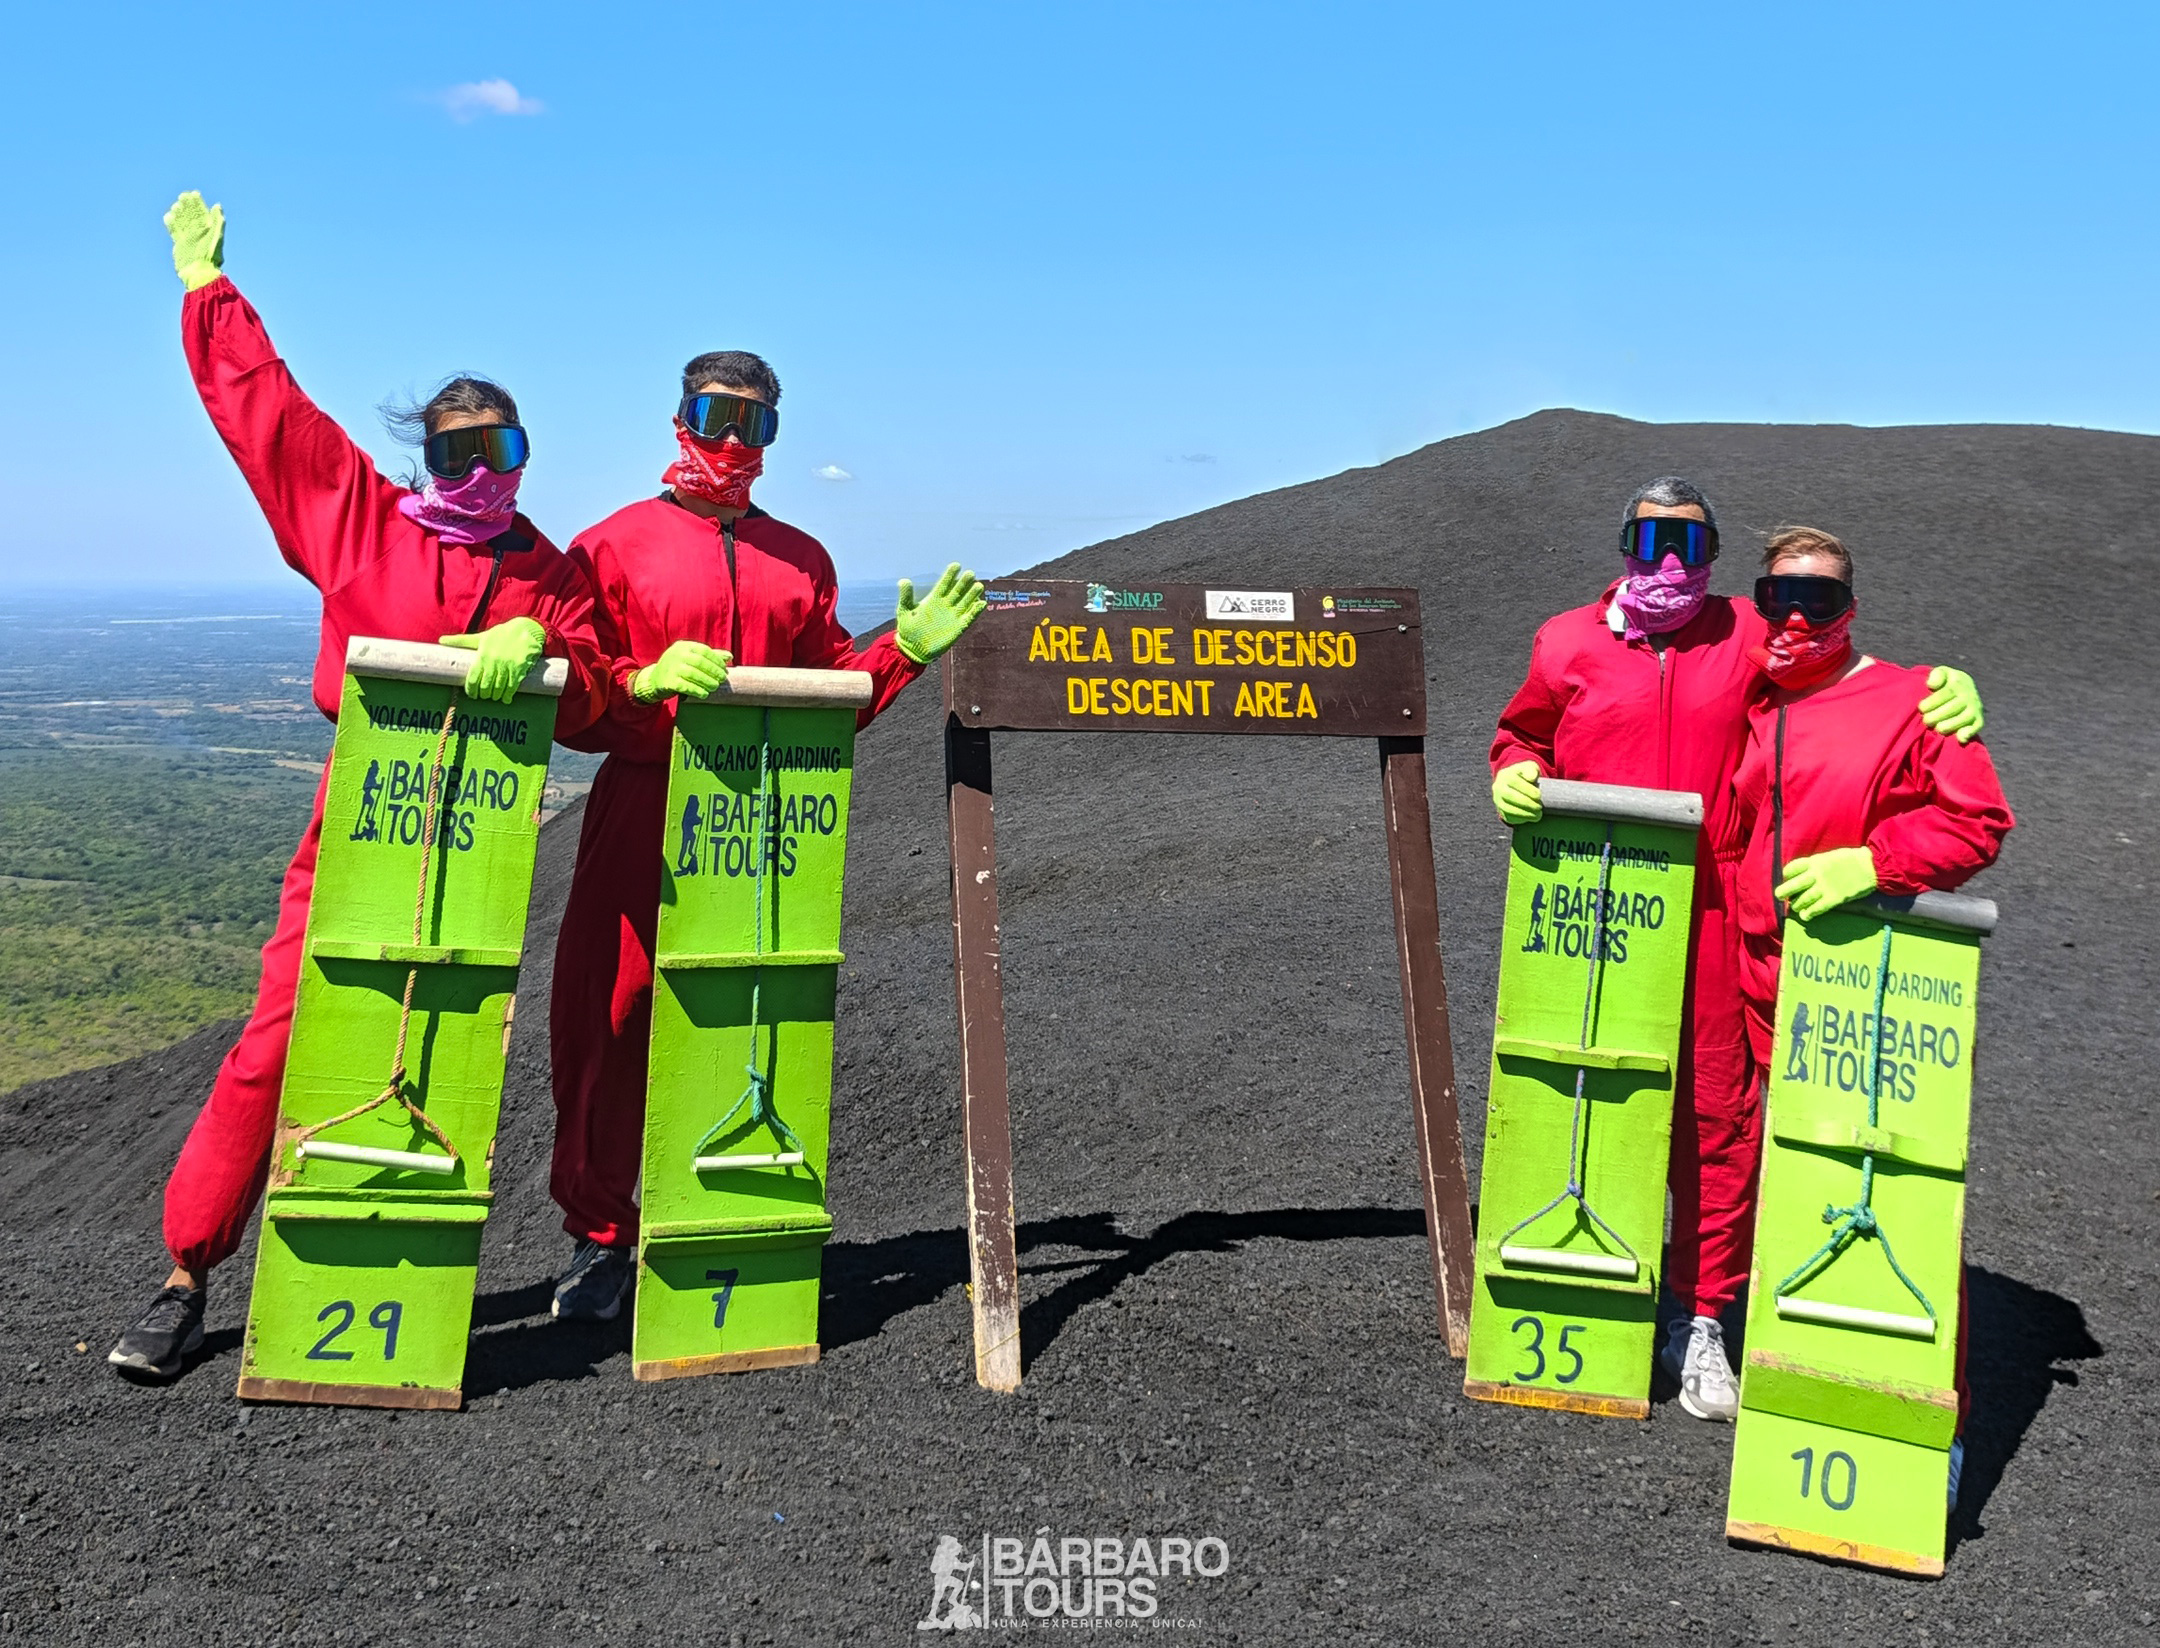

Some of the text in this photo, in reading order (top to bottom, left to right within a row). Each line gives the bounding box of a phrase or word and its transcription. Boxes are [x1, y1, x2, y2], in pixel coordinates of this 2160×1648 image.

[1029, 617, 1356, 668] ÁREA DE DESCENSO
[369, 705, 444, 735] VOLCANO
[1067, 677, 1318, 718] DESCENT AREA
[390, 748, 518, 811] BÁRBARO
[683, 745, 758, 771] VOLCANO
[387, 805, 475, 851] TOURS
[1532, 836, 1596, 863] VOLCANO
[709, 836, 798, 877] TOURS
[1553, 875, 1665, 930] BÁRBARO
[1552, 921, 1628, 963] TOURS
[1792, 951, 1962, 1007] VOLCANO OARDING
[1820, 1047, 1916, 1103] TOURS
[706, 1269, 739, 1328] 7
[305, 1300, 403, 1360] 29
[1511, 1316, 1588, 1384] 35
[1791, 1447, 1857, 1511] 10
